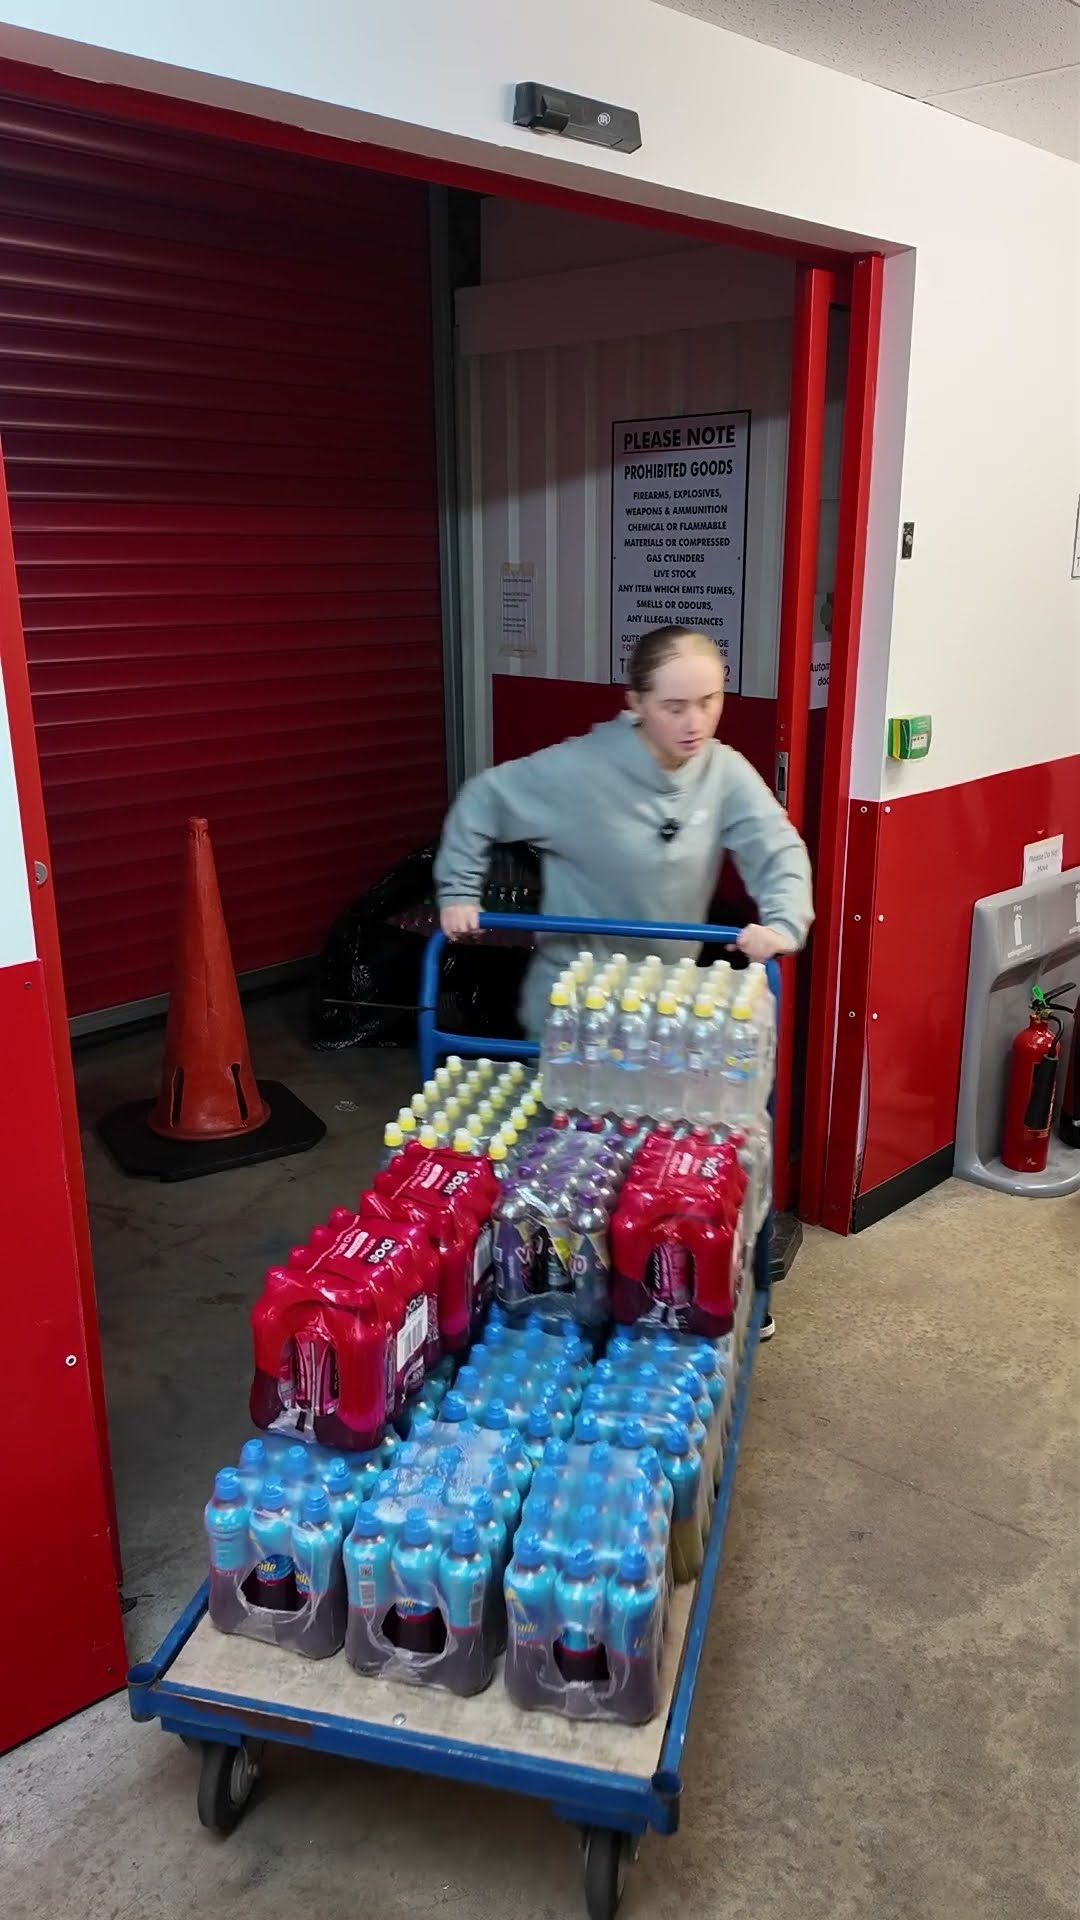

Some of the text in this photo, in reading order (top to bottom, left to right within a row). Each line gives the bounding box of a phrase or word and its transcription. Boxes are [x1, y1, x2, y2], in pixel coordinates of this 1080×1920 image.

[624, 425, 736, 450] PLEASE NOTE
[624, 459, 733, 480] PROHIBITED GOODS
[633, 488, 722, 500] FIREARMS, EXPLOSIVES,
[625, 505, 728, 516] WEAPONS & AMMUNITION
[628, 521, 727, 532] CHEMICAL OR FLAMMABLE
[624, 537, 731, 547] MATERIALS OR COMPRESSED
[646, 554, 705, 563] GAS CYLINDERS
[654, 569, 696, 578] LIVE STOCK
[618, 584, 735, 596] ANY ITEM WHICH EMITS FUMES,
[636, 600, 714, 611] SMELLS OR ODOURS,
[627, 615, 724, 626] ANY ILLEGAL SUBSTANCES
